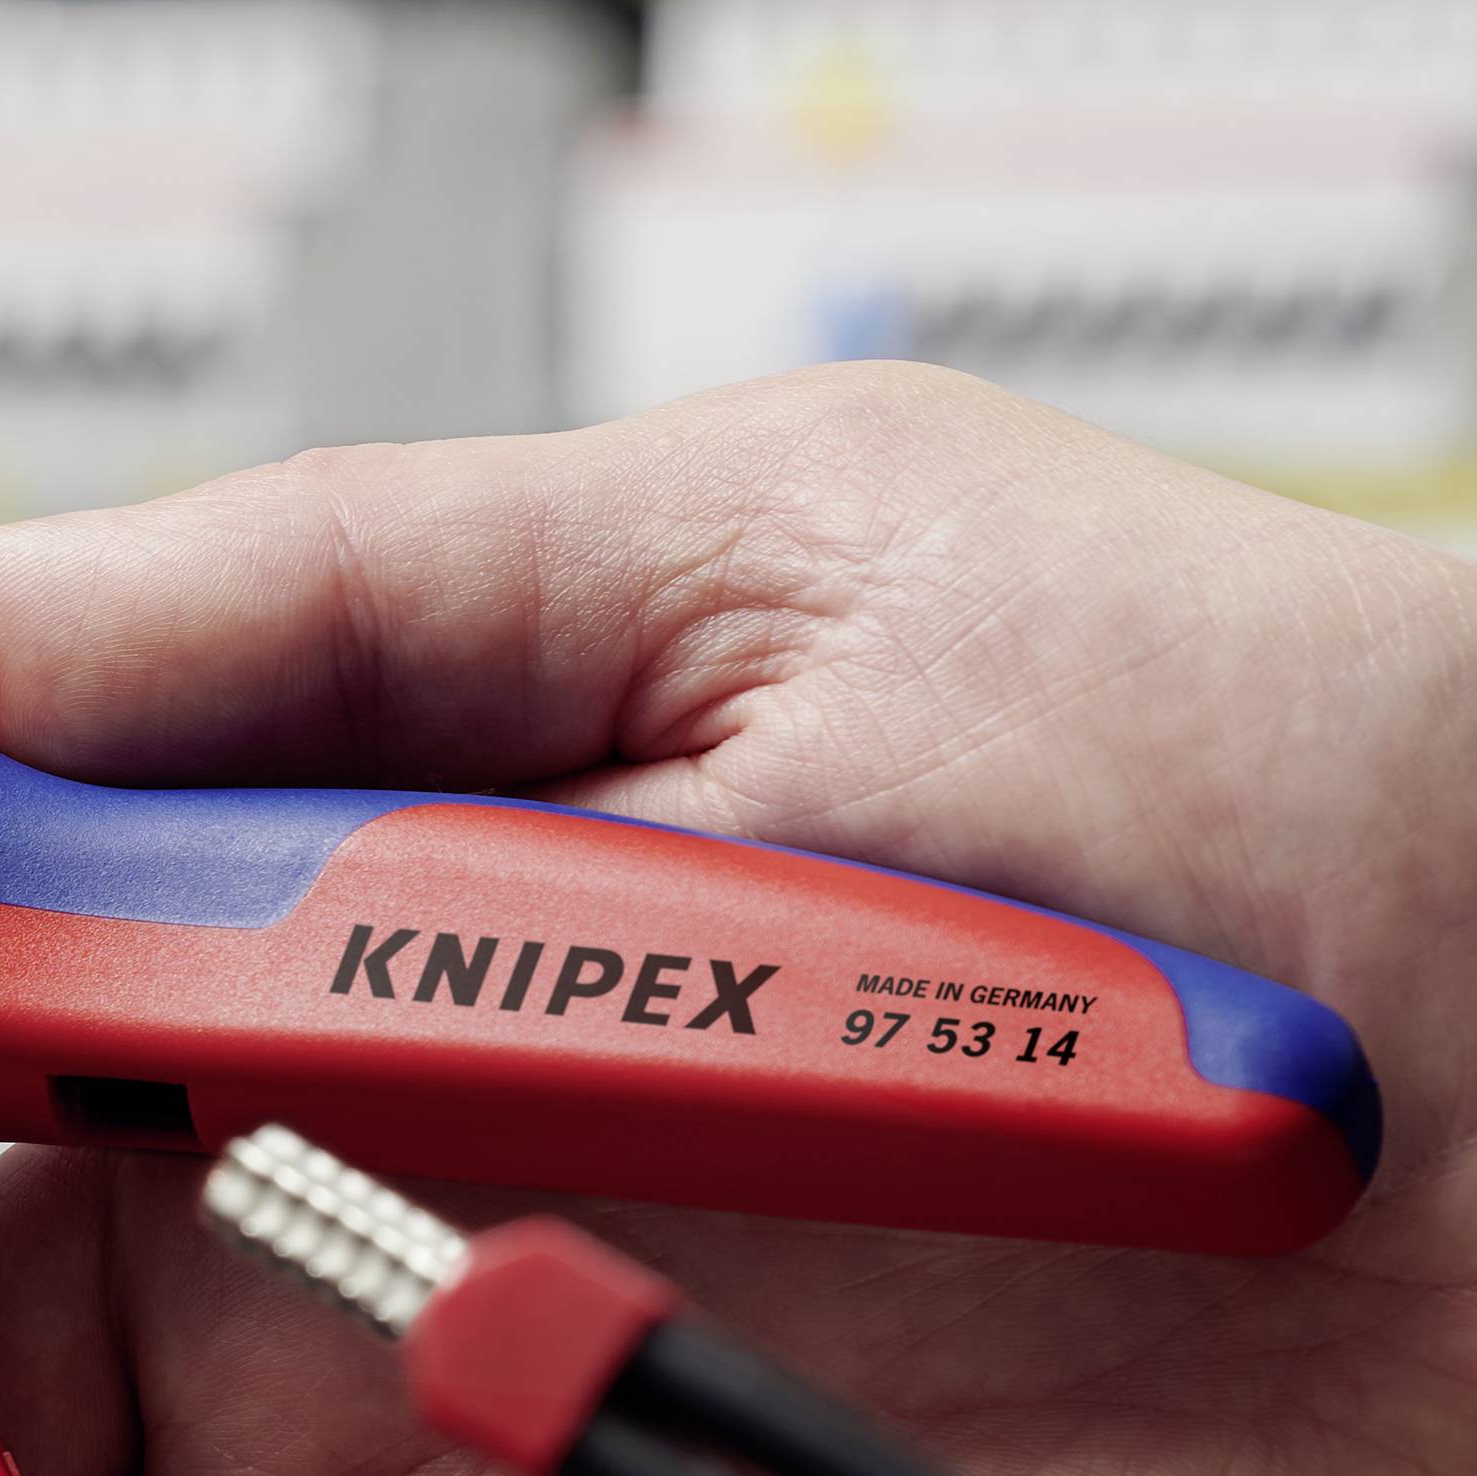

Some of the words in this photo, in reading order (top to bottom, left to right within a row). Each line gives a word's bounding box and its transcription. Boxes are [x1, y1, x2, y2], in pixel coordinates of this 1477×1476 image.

[328, 923, 782, 1037] KNIPEX
[855, 972, 932, 1000] MADE
[934, 980, 966, 1003] IN
[968, 984, 1099, 1016] GERMANY
[839, 1008, 912, 1049] 97
[925, 1016, 998, 1059] 53
[1014, 1025, 1081, 1068] 14
